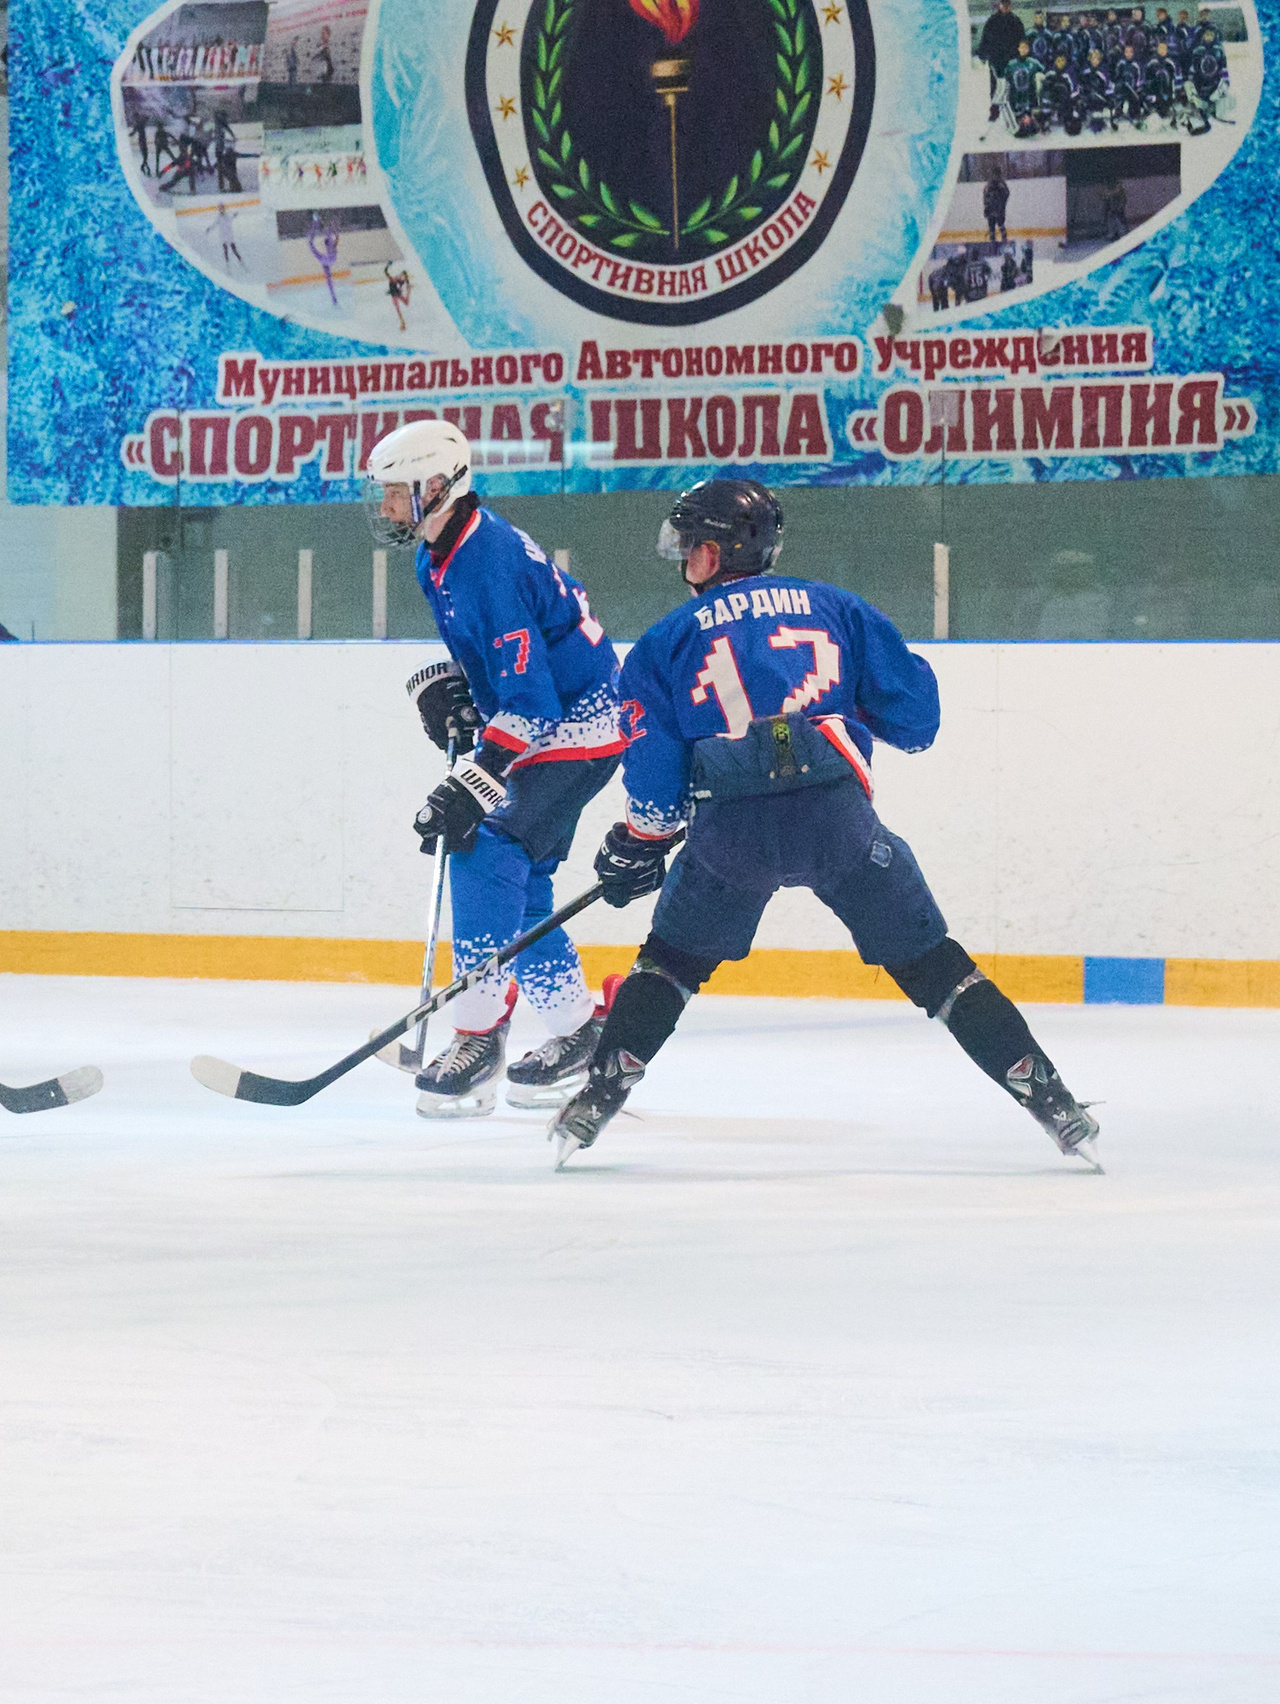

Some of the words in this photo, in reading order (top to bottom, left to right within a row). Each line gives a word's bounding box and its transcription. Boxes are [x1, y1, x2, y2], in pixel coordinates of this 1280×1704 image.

[526, 201, 708, 297] СПОРТИВНАЯ
[715, 191, 817, 284] ШКОЛА
[222, 352, 564, 404] Муниципального
[576, 339, 858, 382] Автономного
[873, 331, 1148, 380] Учреждения
[590, 393, 828, 461] ШКОЛА
[851, 379, 1251, 456] «ОЛИМПИЯ»
[693, 587, 813, 631] БАРДИН
